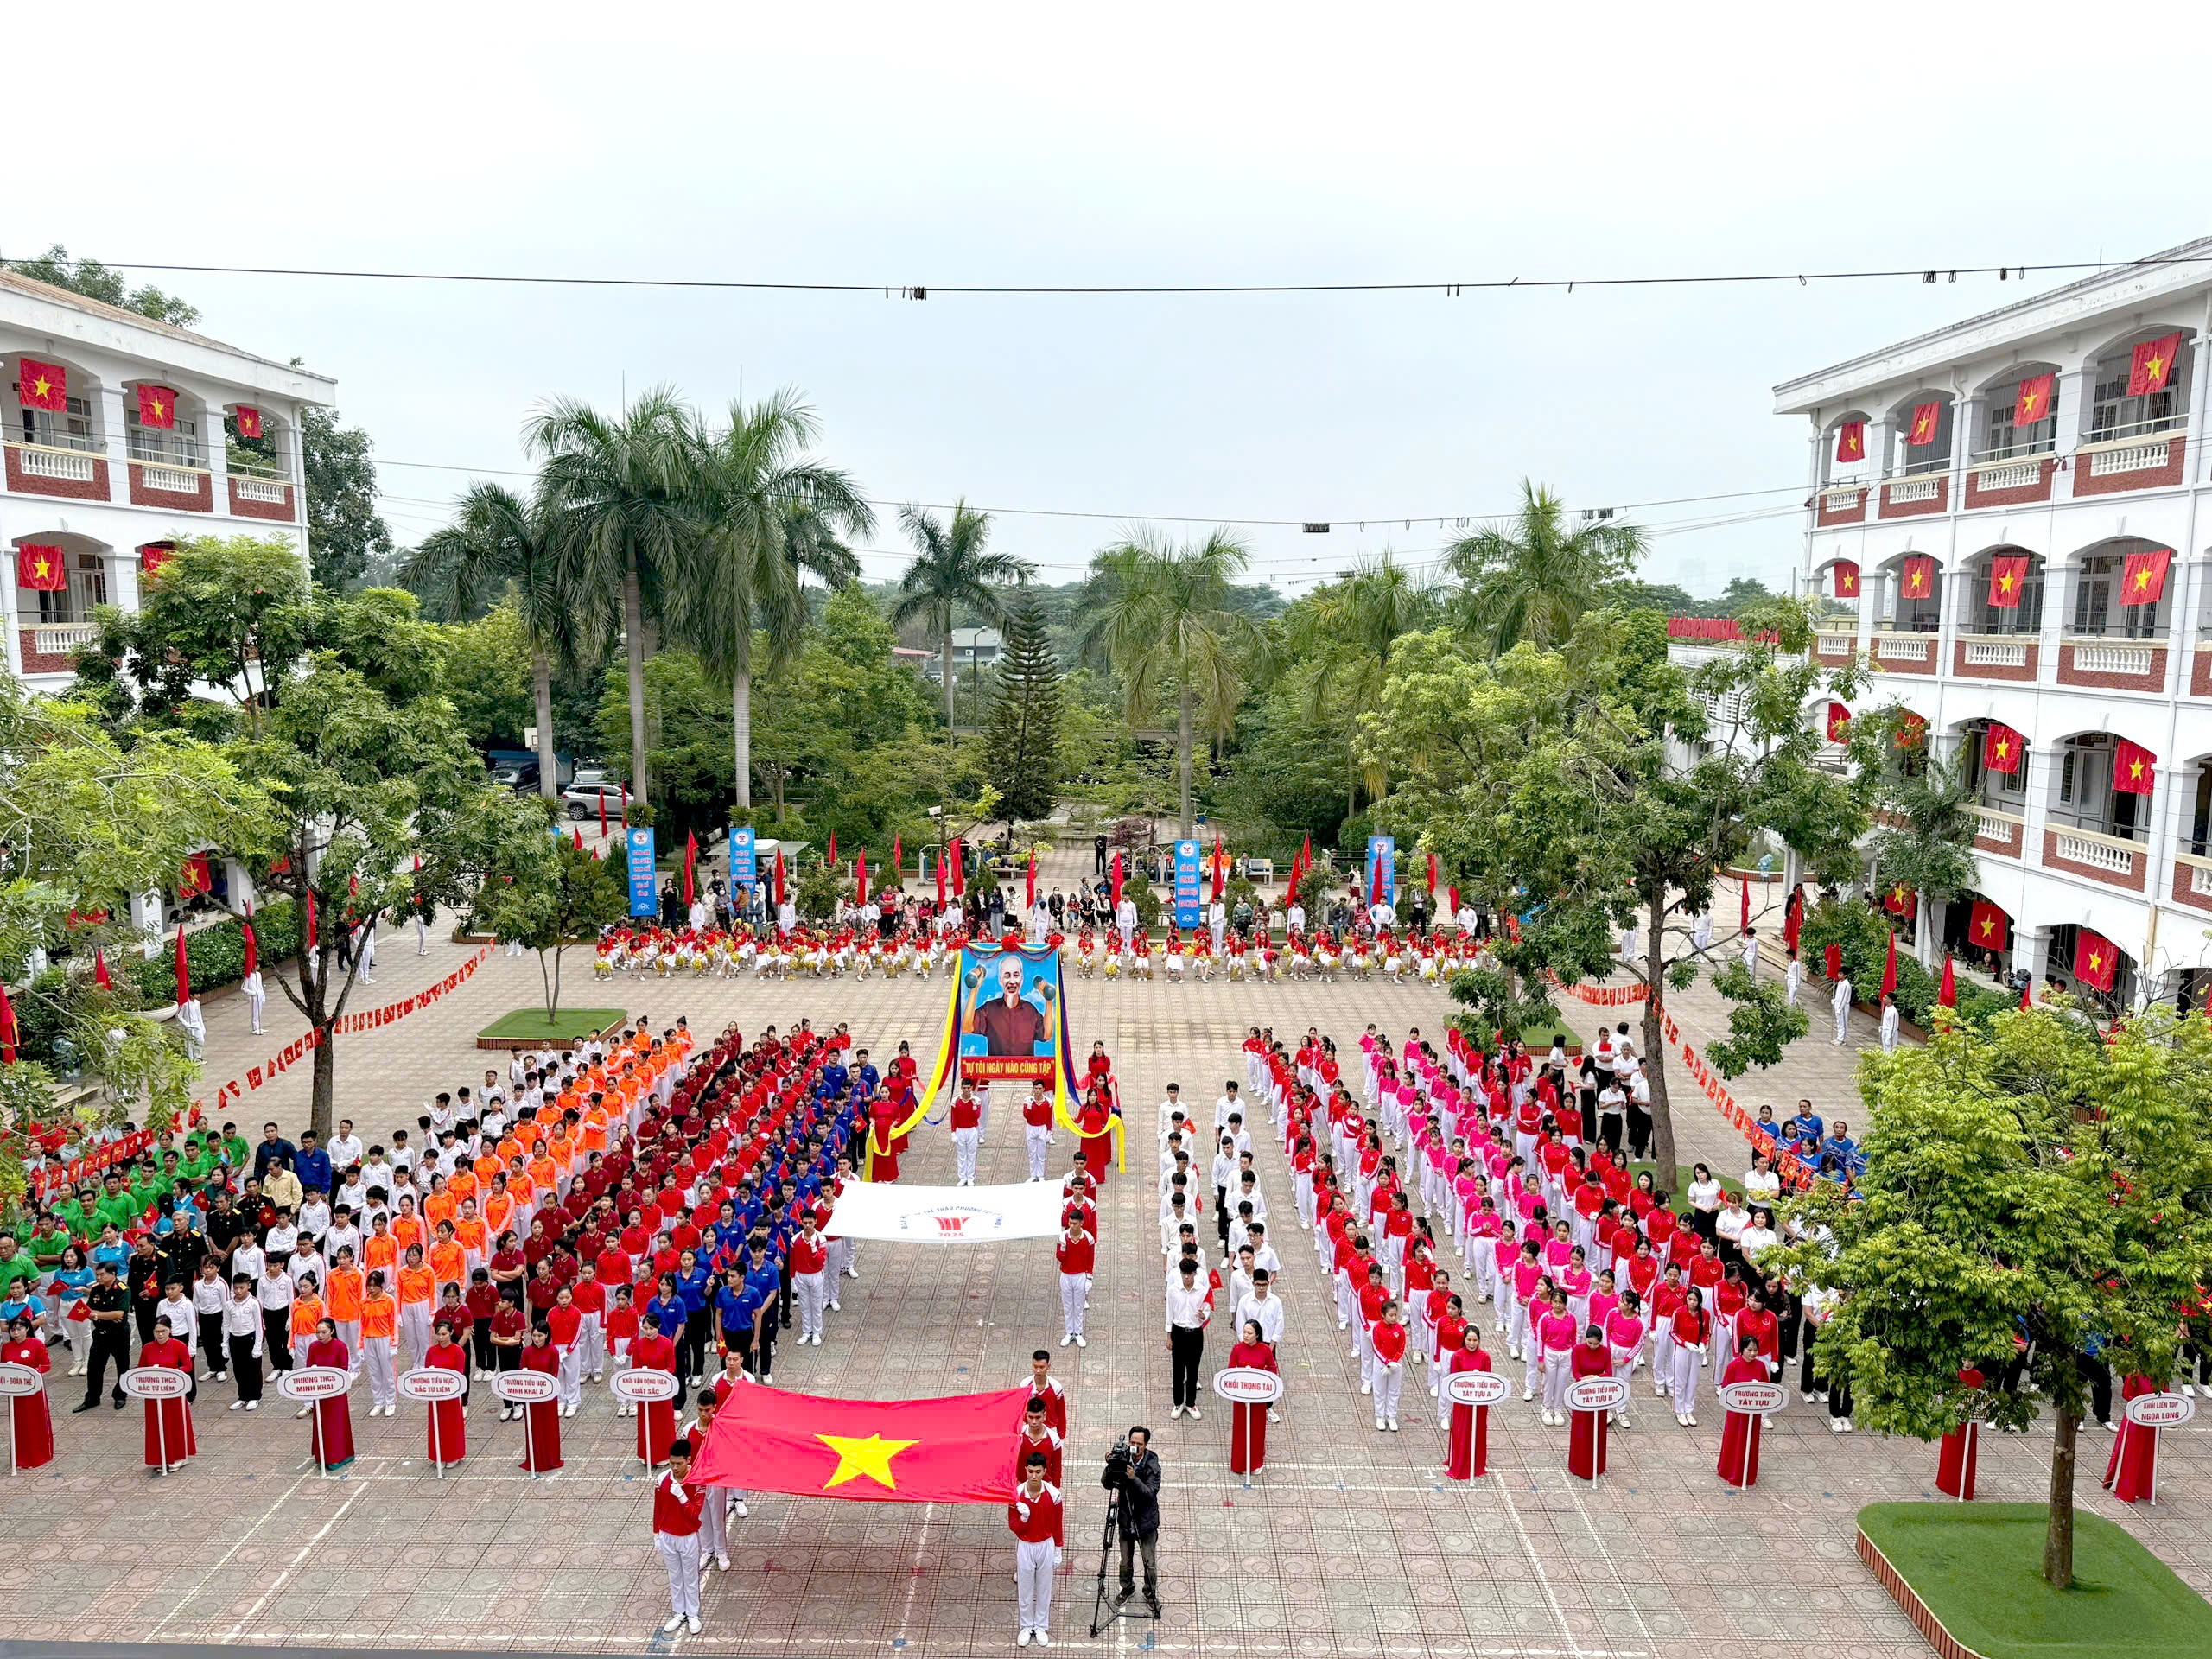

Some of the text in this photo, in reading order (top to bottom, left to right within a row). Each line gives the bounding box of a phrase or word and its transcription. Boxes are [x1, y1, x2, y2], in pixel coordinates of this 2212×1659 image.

[975, 1060, 985, 1073] TÔI
[987, 1060, 1003, 1074] NGÀY
[1005, 1060, 1019, 1074] NÀO
[1020, 1060, 1038, 1074] CŨNG
[23, 1376, 32, 1386] THỂ
[431, 1376, 442, 1384] TIỂU
[524, 1377, 536, 1386] TIỂU
[1477, 1378, 1488, 1389] TIỂU
[1224, 1378, 1273, 1392] KHỐI TRỌNG TÀI
[1577, 1387, 1596, 1395] TRƯỜNG
[1597, 1384, 1608, 1394] TIỂU
[1755, 1399, 1770, 1408] TỰU
[2143, 1401, 2155, 1409] KHỐI
[2141, 1412, 2159, 1421] NGỌA
